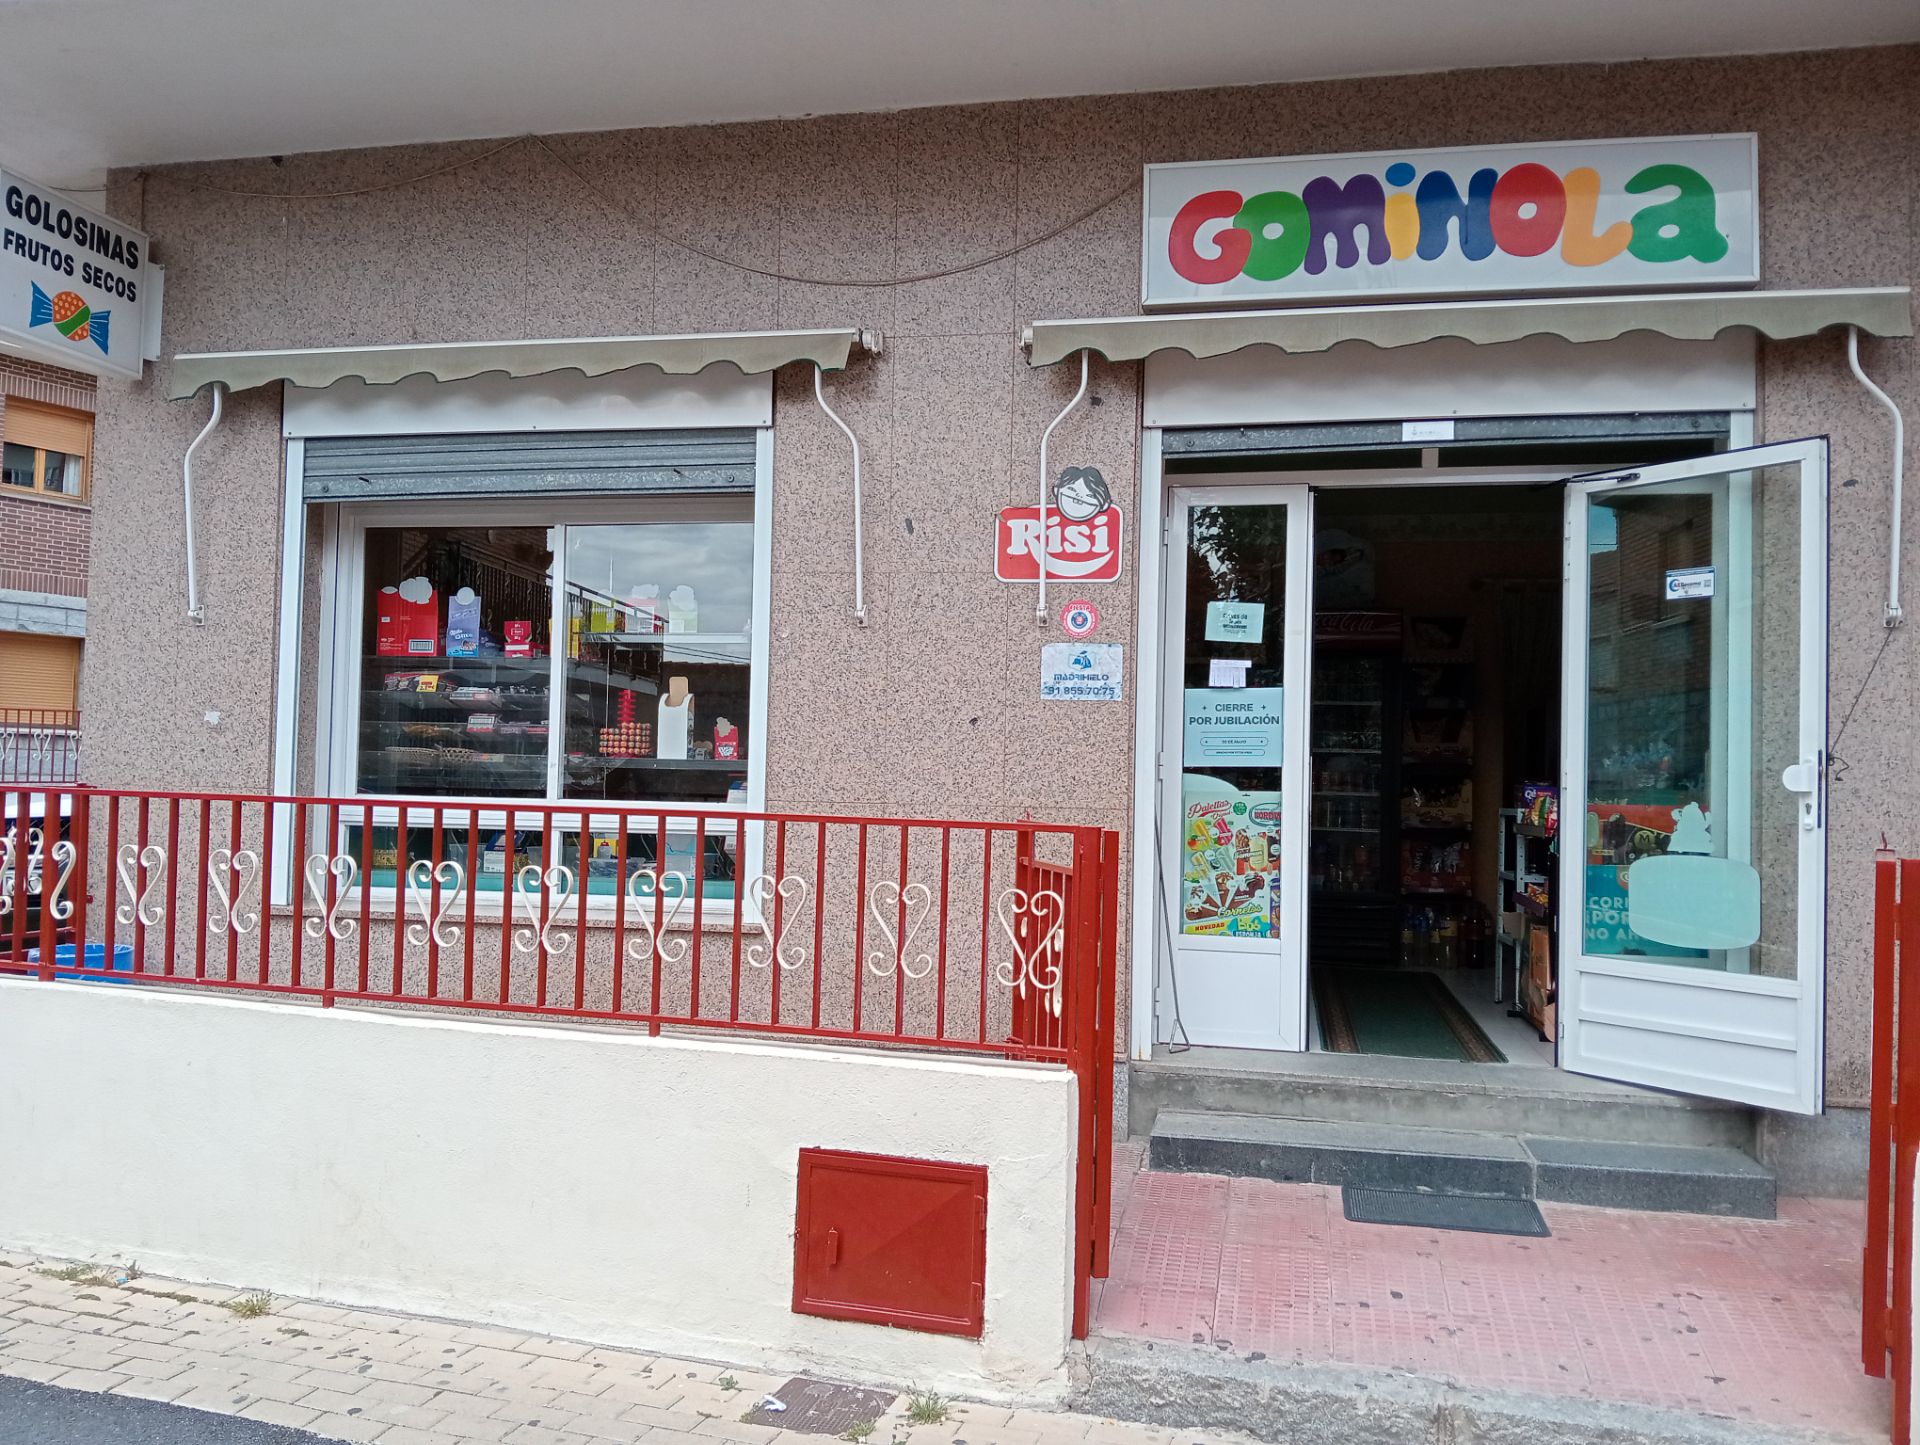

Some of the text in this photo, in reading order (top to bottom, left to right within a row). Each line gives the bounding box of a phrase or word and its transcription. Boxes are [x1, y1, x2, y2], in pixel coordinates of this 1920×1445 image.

[5, 185, 140, 270] GOLOSINAS
[3, 227, 137, 303] FRUTOS SECOS
[1006, 515, 1111, 559] Risi
[1053, 673, 1110, 681] MADRIHIELO
[1214, 703, 1254, 712] CIERRE
[1189, 713, 1280, 726] POR JUBILACIÓN
[1194, 922, 1225, 932] NOVEDAD
